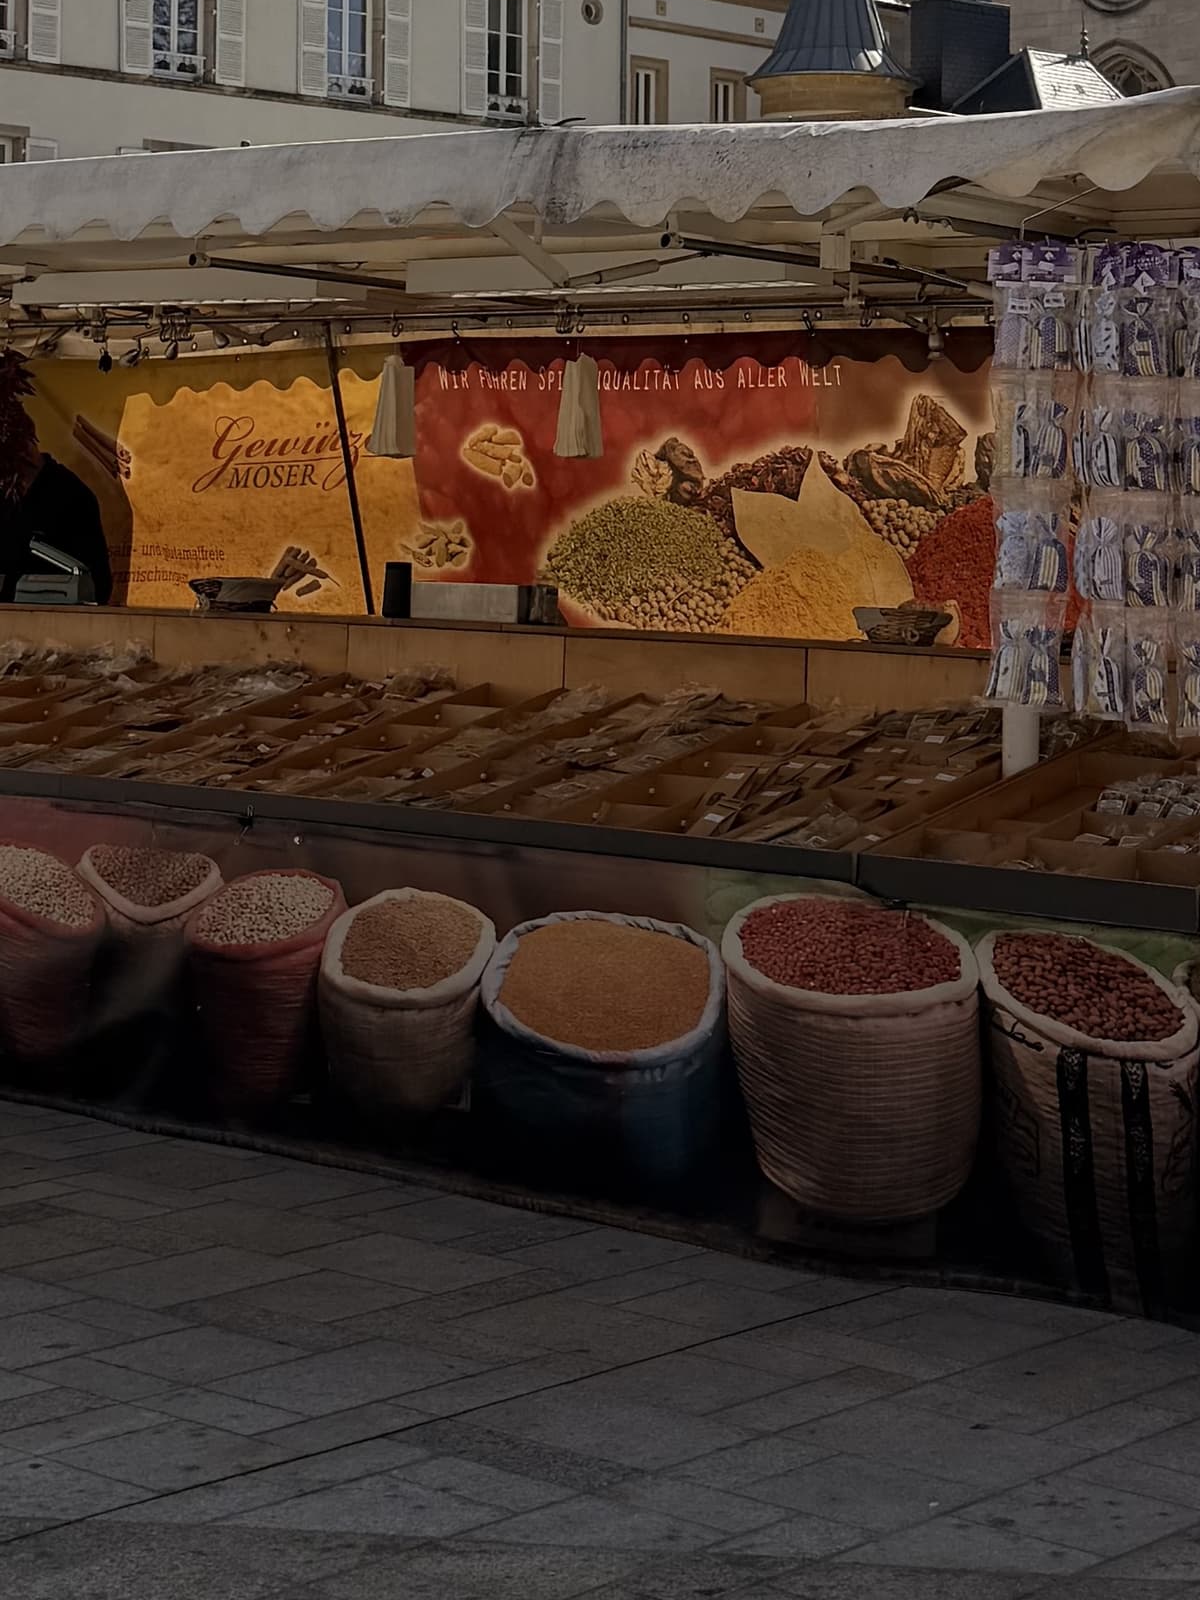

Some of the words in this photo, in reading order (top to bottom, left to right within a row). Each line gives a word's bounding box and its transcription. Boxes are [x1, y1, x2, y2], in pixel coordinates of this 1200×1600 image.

[694, 368, 726, 389] AUS
[737, 366, 788, 388] ALLER
[799, 359, 842, 388] WELT
[227, 463, 318, 490] MOSER
